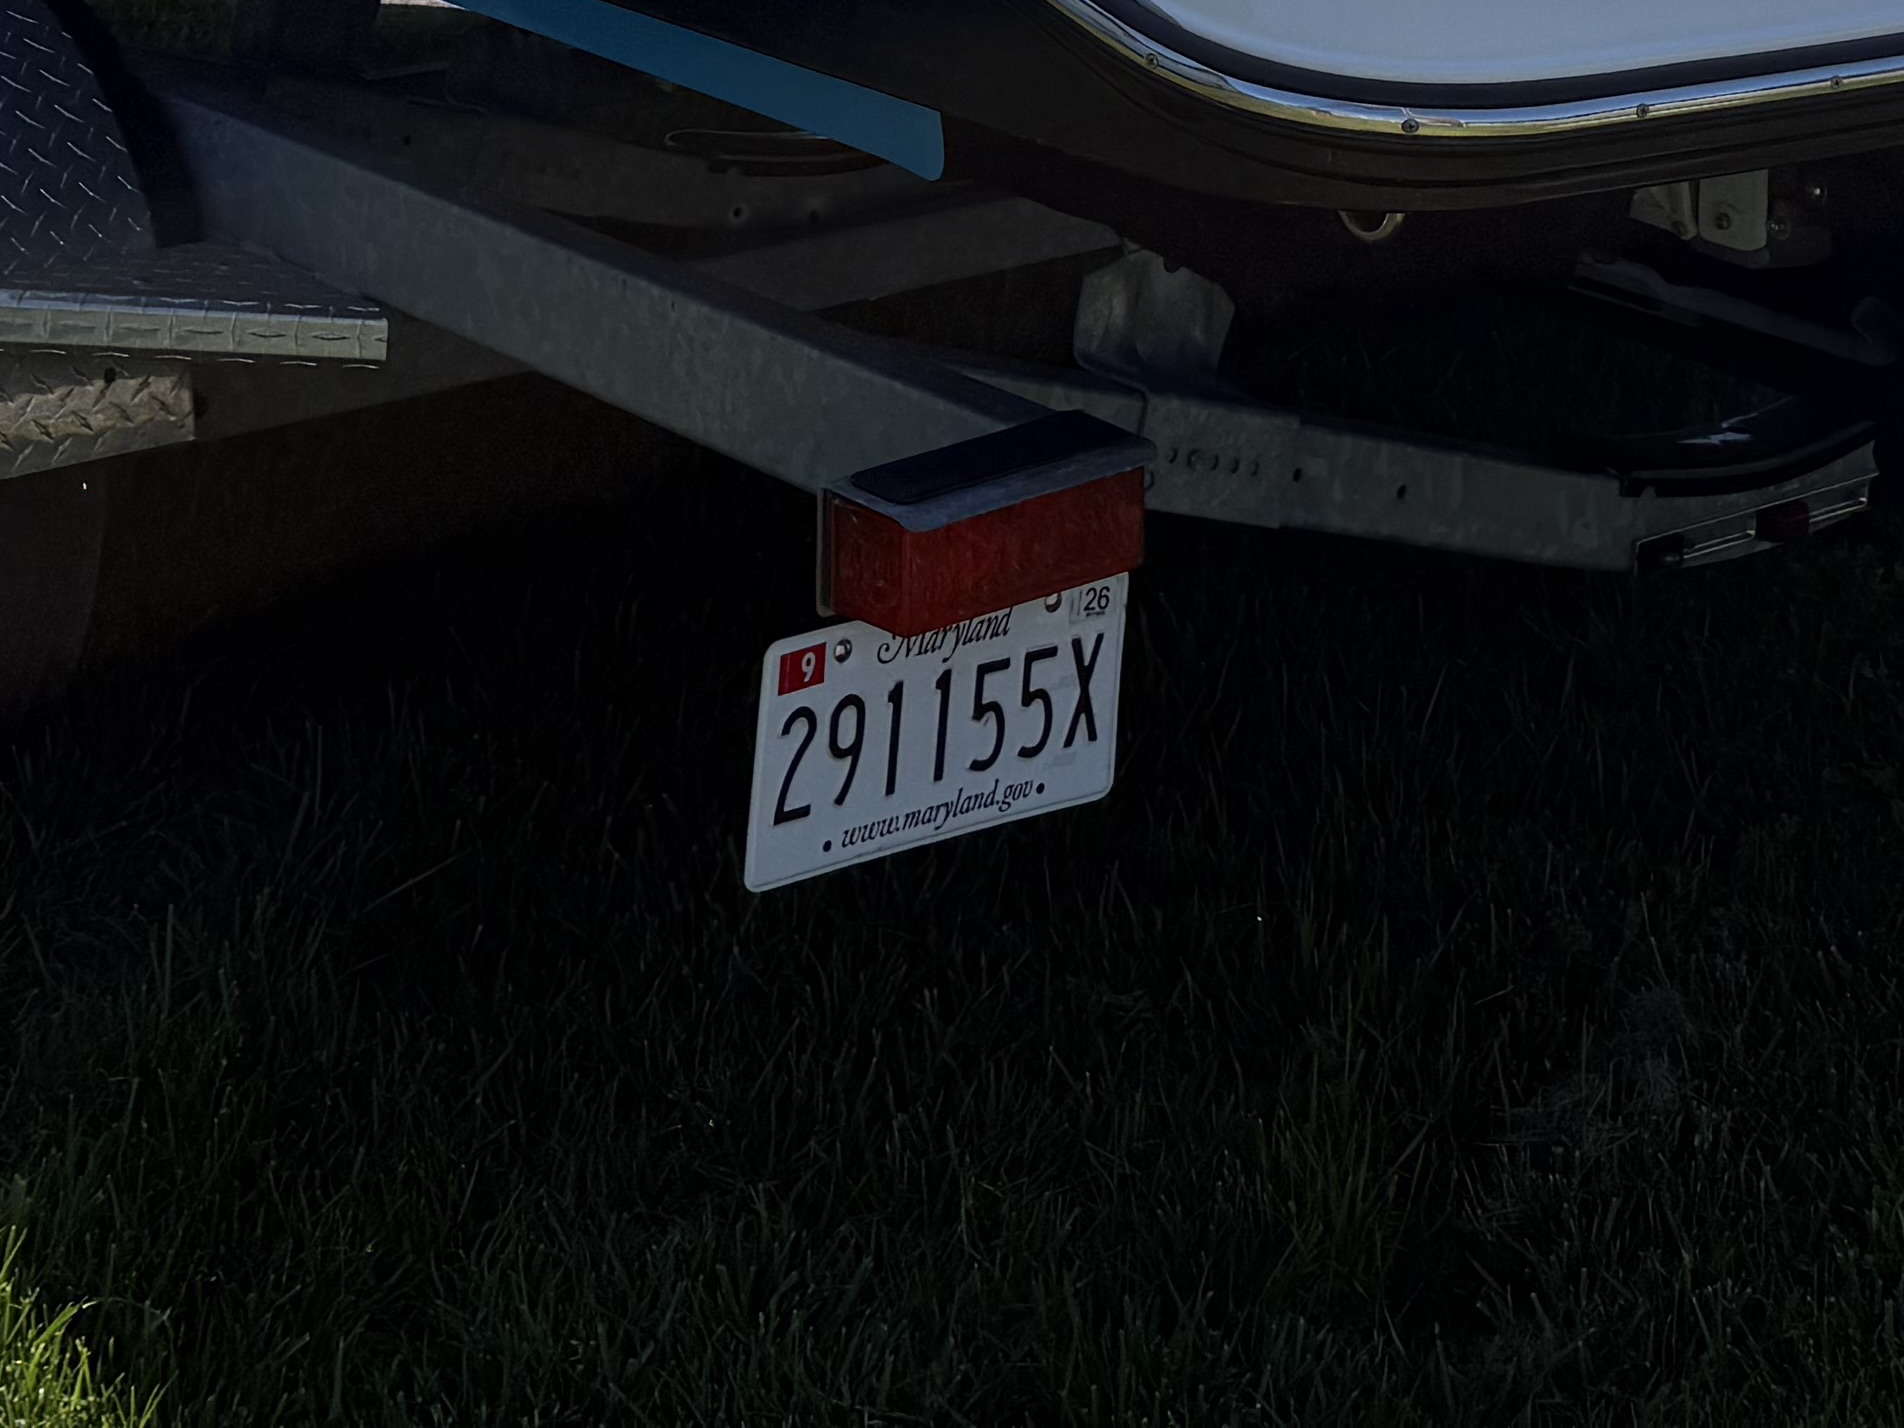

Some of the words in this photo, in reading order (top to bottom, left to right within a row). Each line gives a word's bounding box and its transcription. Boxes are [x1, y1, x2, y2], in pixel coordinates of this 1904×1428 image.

[1083, 585, 1110, 612] 26
[876, 608, 1012, 665] Maryland
[800, 650, 815, 683] 9
[772, 632, 1105, 827] 291155X
[842, 777, 1034, 848] www.maryland.gov
